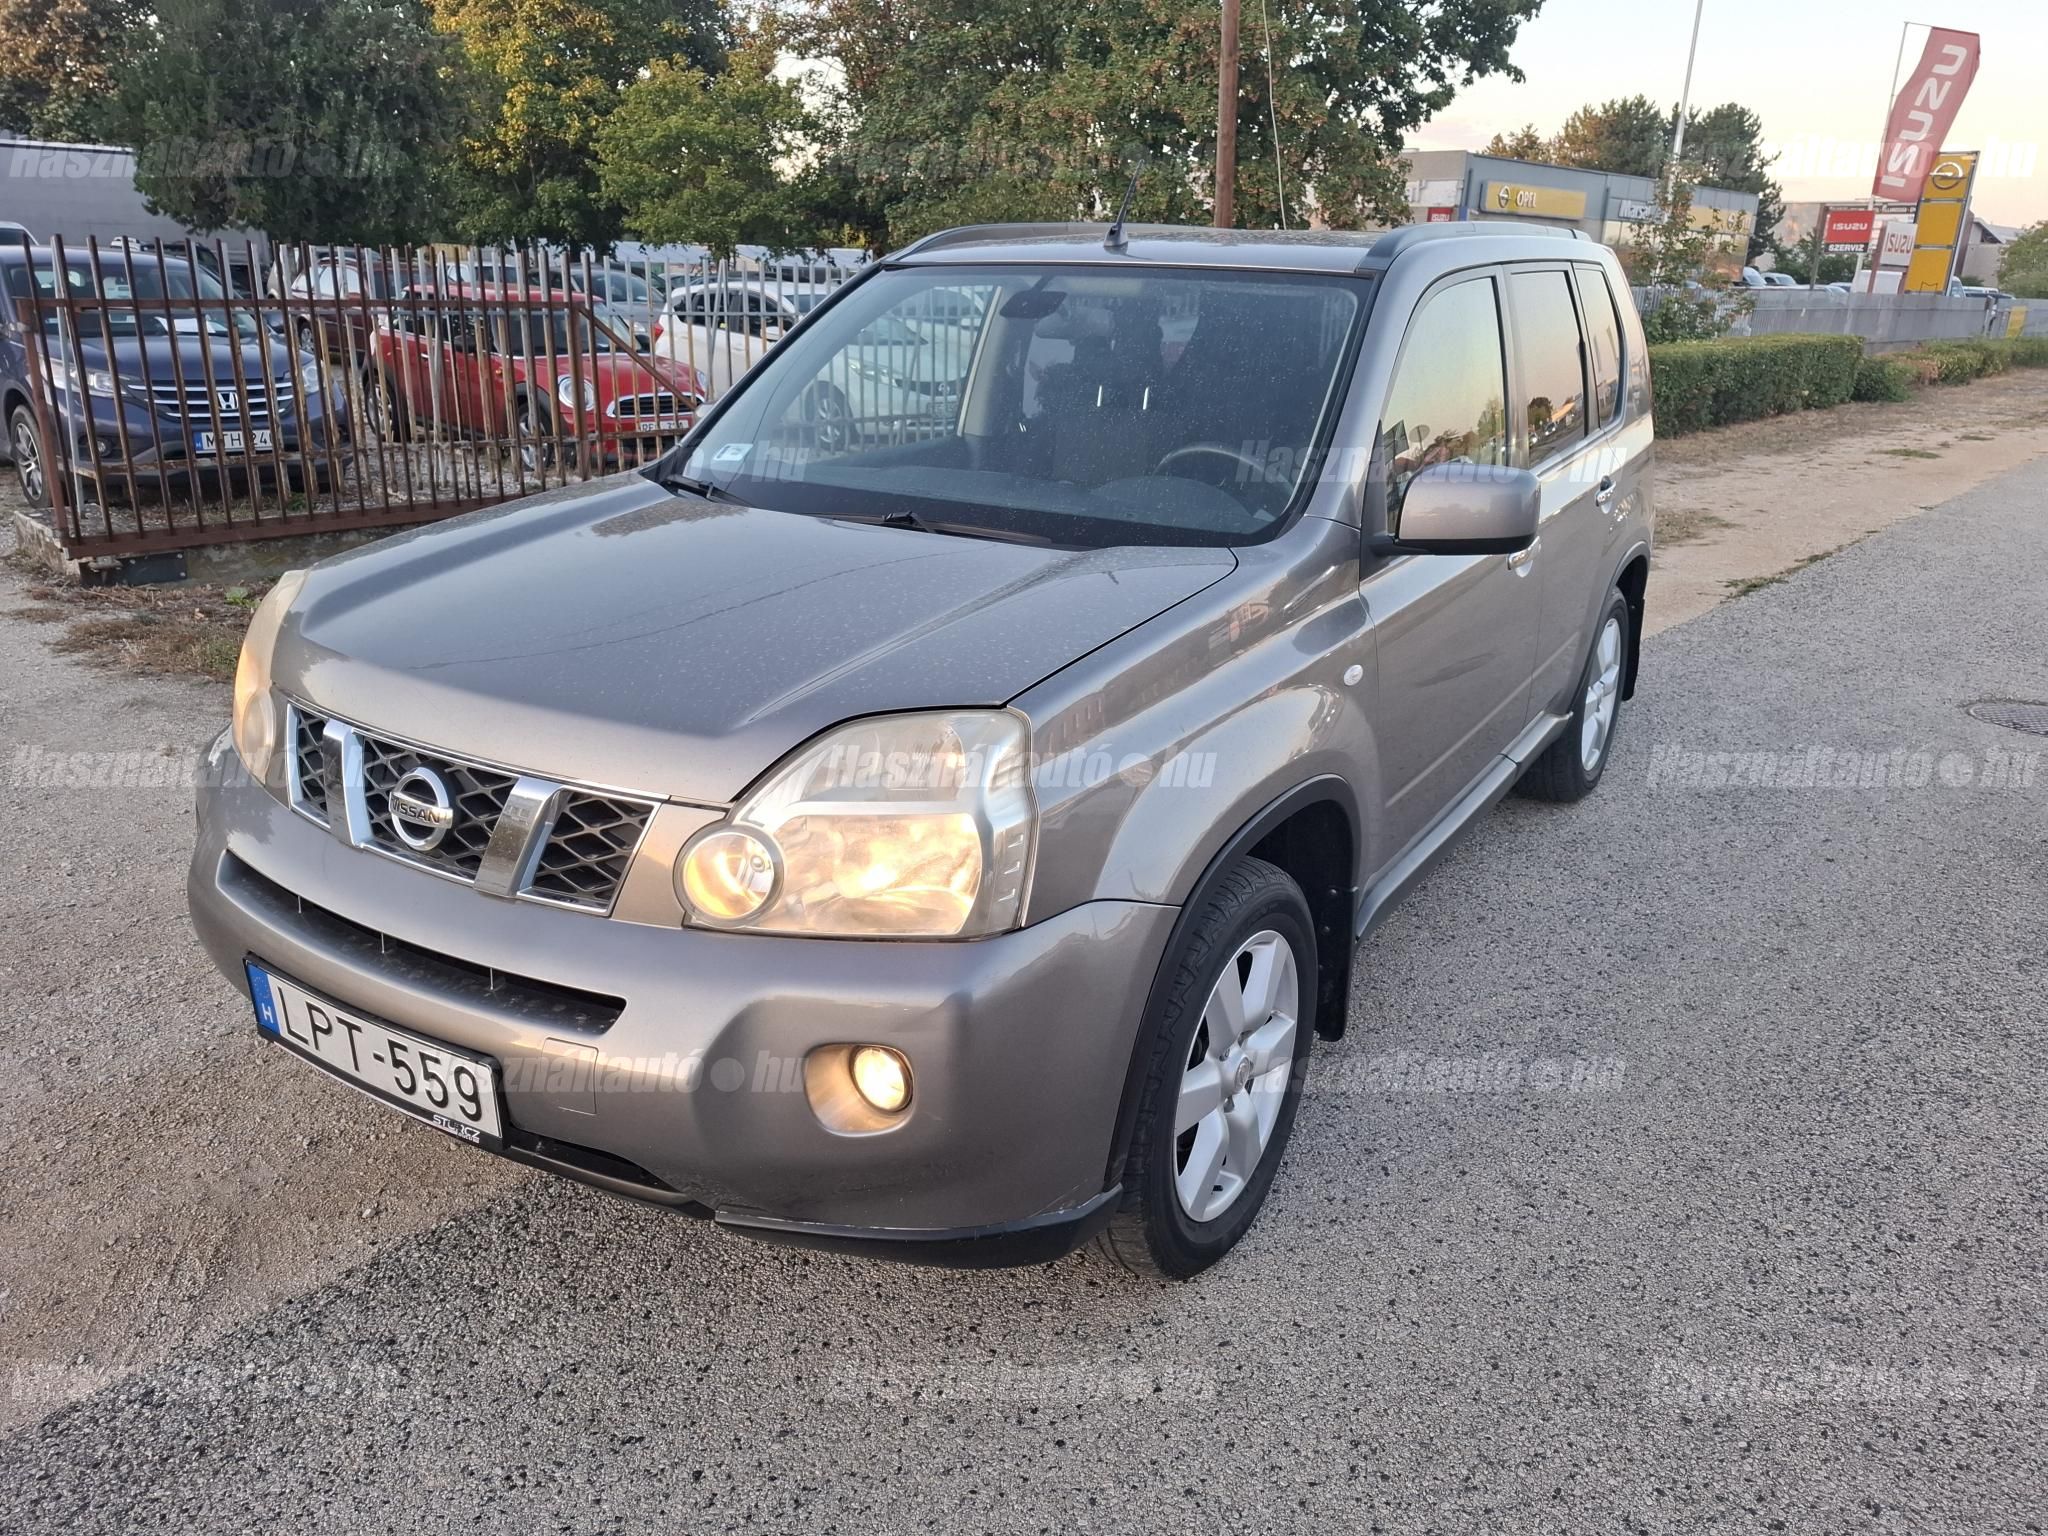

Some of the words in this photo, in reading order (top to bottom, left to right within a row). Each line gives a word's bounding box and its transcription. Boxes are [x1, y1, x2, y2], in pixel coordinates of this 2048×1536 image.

[1880, 43, 1967, 188] ISUZU
[1516, 190, 1537, 208] OPEL
[1832, 222, 1868, 231] ISUZU
[1828, 243, 1865, 252] SZERVIZ
[1884, 232, 1913, 254] ISUZU
[392, 799, 440, 825] NISSAN
[262, 1002, 274, 1024] H
[277, 986, 482, 1122] LPT-559
